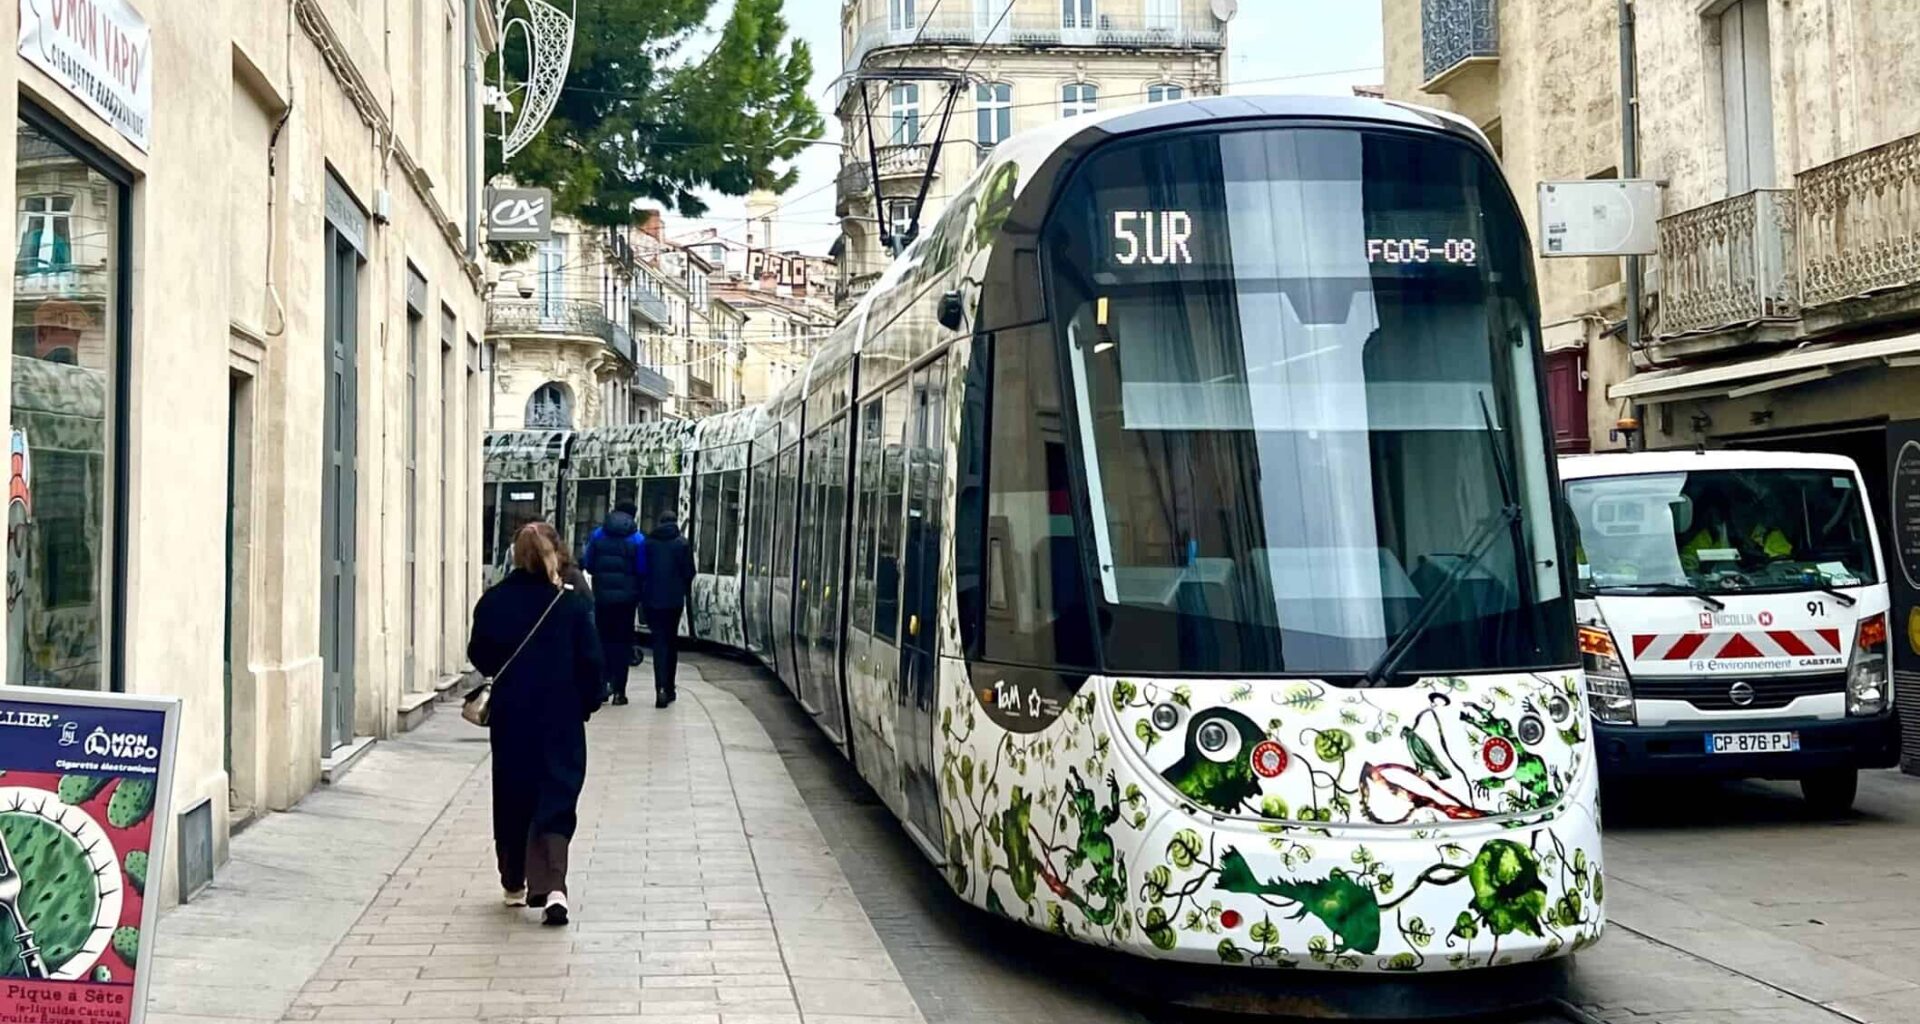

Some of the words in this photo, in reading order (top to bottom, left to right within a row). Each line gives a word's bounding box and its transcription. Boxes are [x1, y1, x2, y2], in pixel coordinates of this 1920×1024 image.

[103, 13, 139, 95] VAPO
[51, 43, 95, 97] CIGARETTE
[1807, 601, 1824, 616] 91
[1708, 659, 1792, 671] environnement
[1799, 657, 1842, 666] CABSTAR
[112, 732, 148, 747] MON
[112, 746, 158, 759] VAPO
[56, 759, 99, 770] Cigarette
[7, 985, 61, 1002] Pique
[85, 989, 124, 1004] Sète
